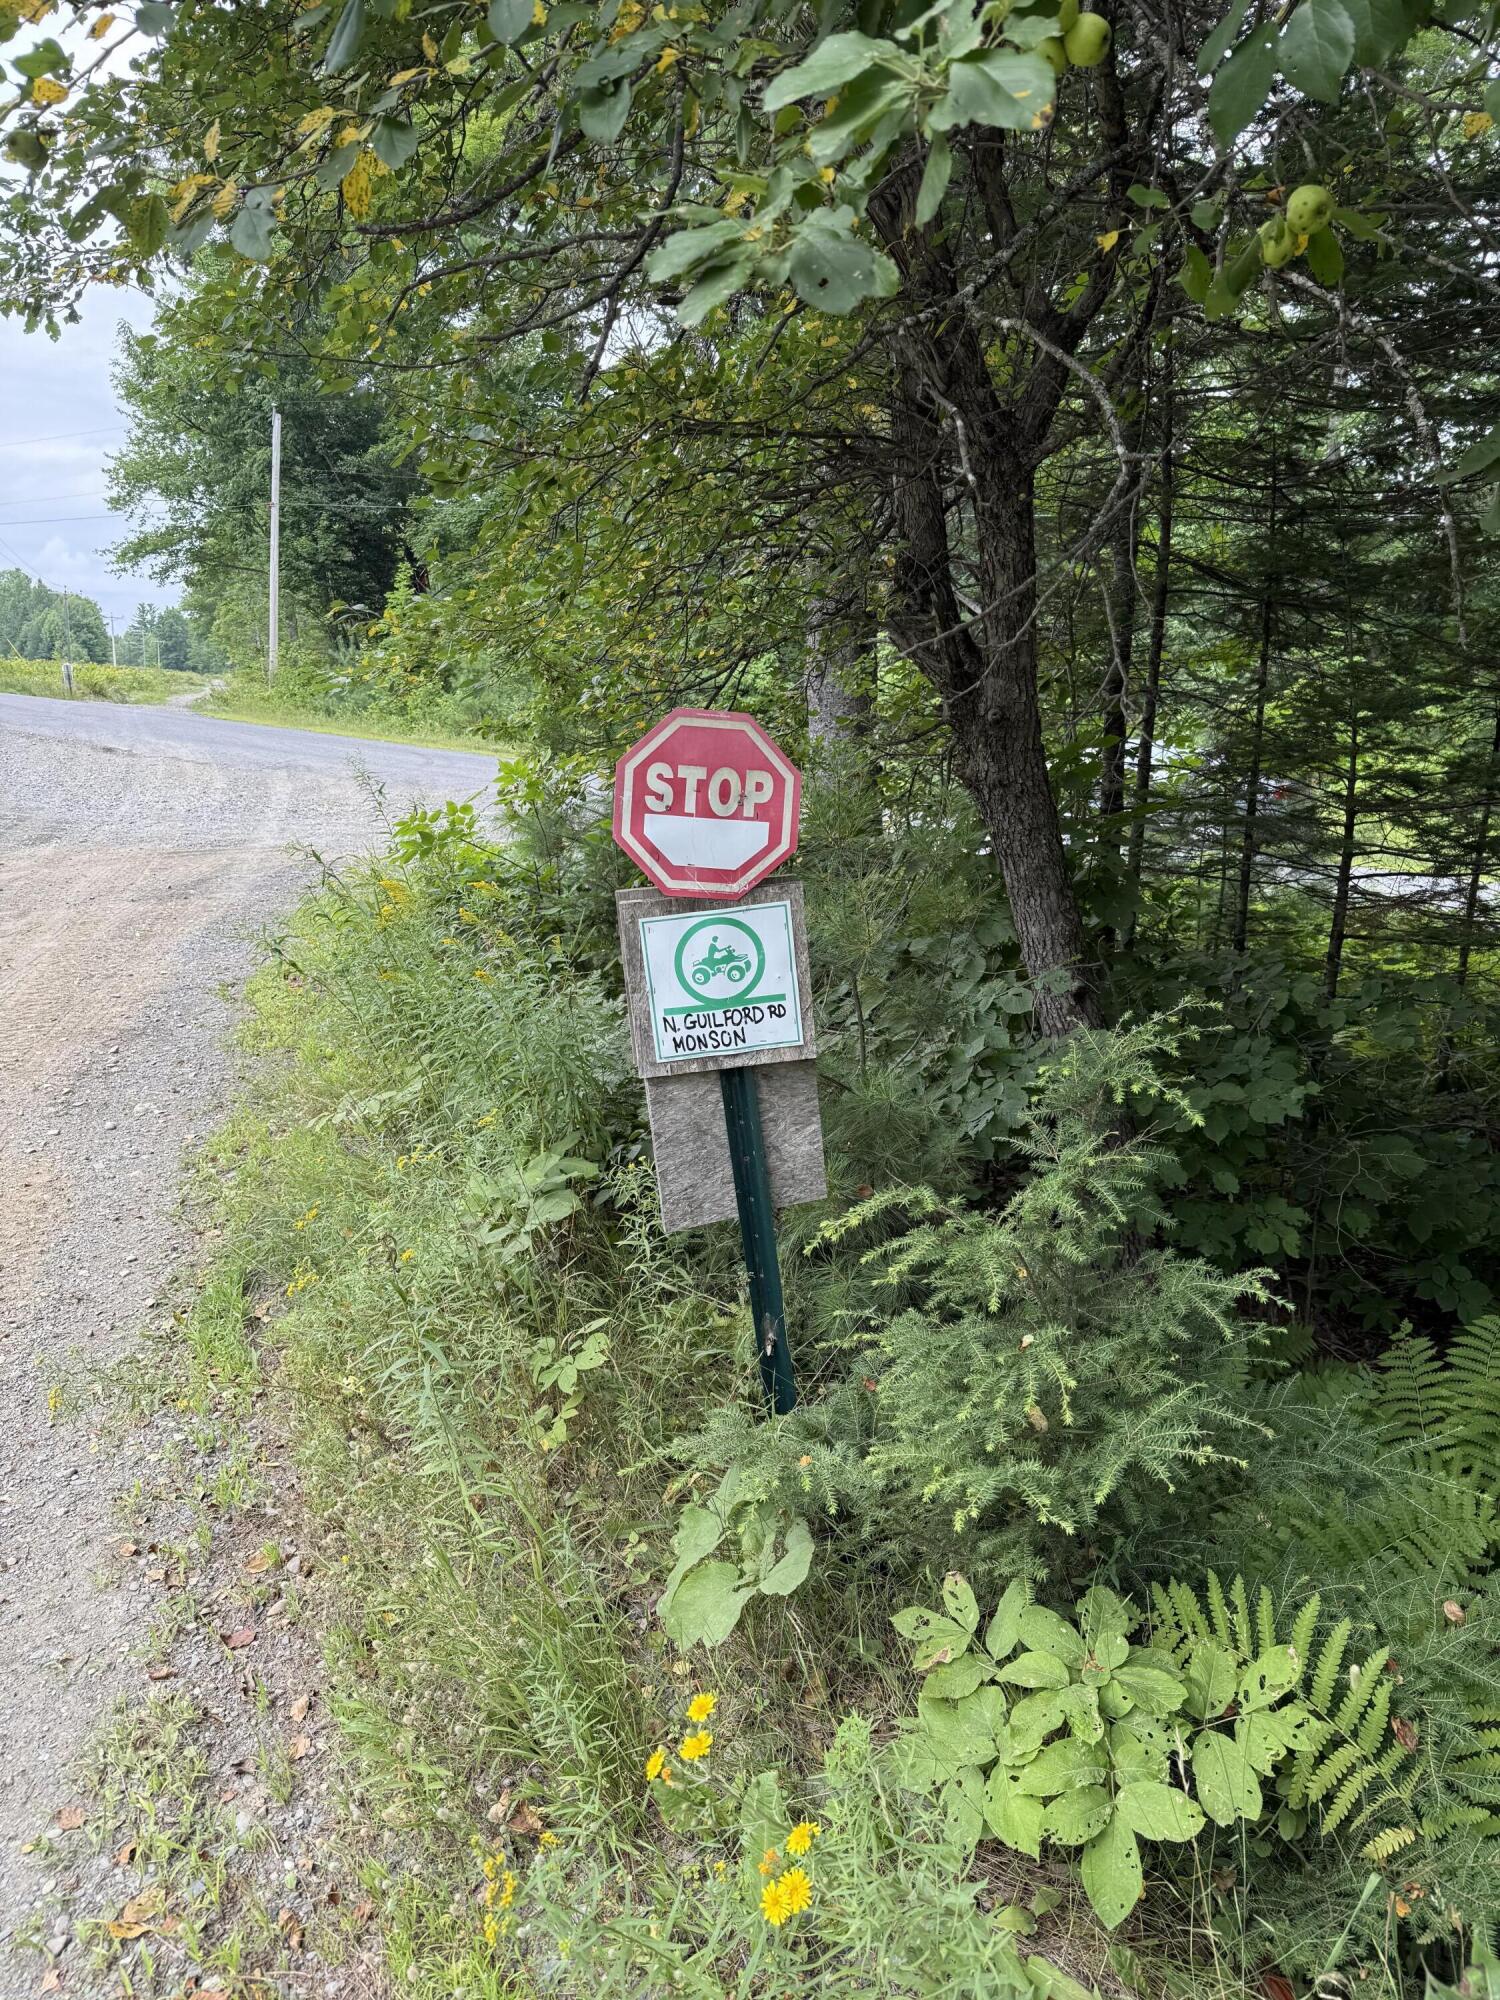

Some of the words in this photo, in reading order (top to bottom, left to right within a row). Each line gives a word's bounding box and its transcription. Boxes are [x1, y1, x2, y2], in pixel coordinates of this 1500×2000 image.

[644, 762, 774, 818] STOP
[662, 1016, 681, 1033] N.
[683, 1005, 765, 1030] GUILFORD
[767, 1003, 786, 1019] RD
[672, 1027, 746, 1053] MONSON
